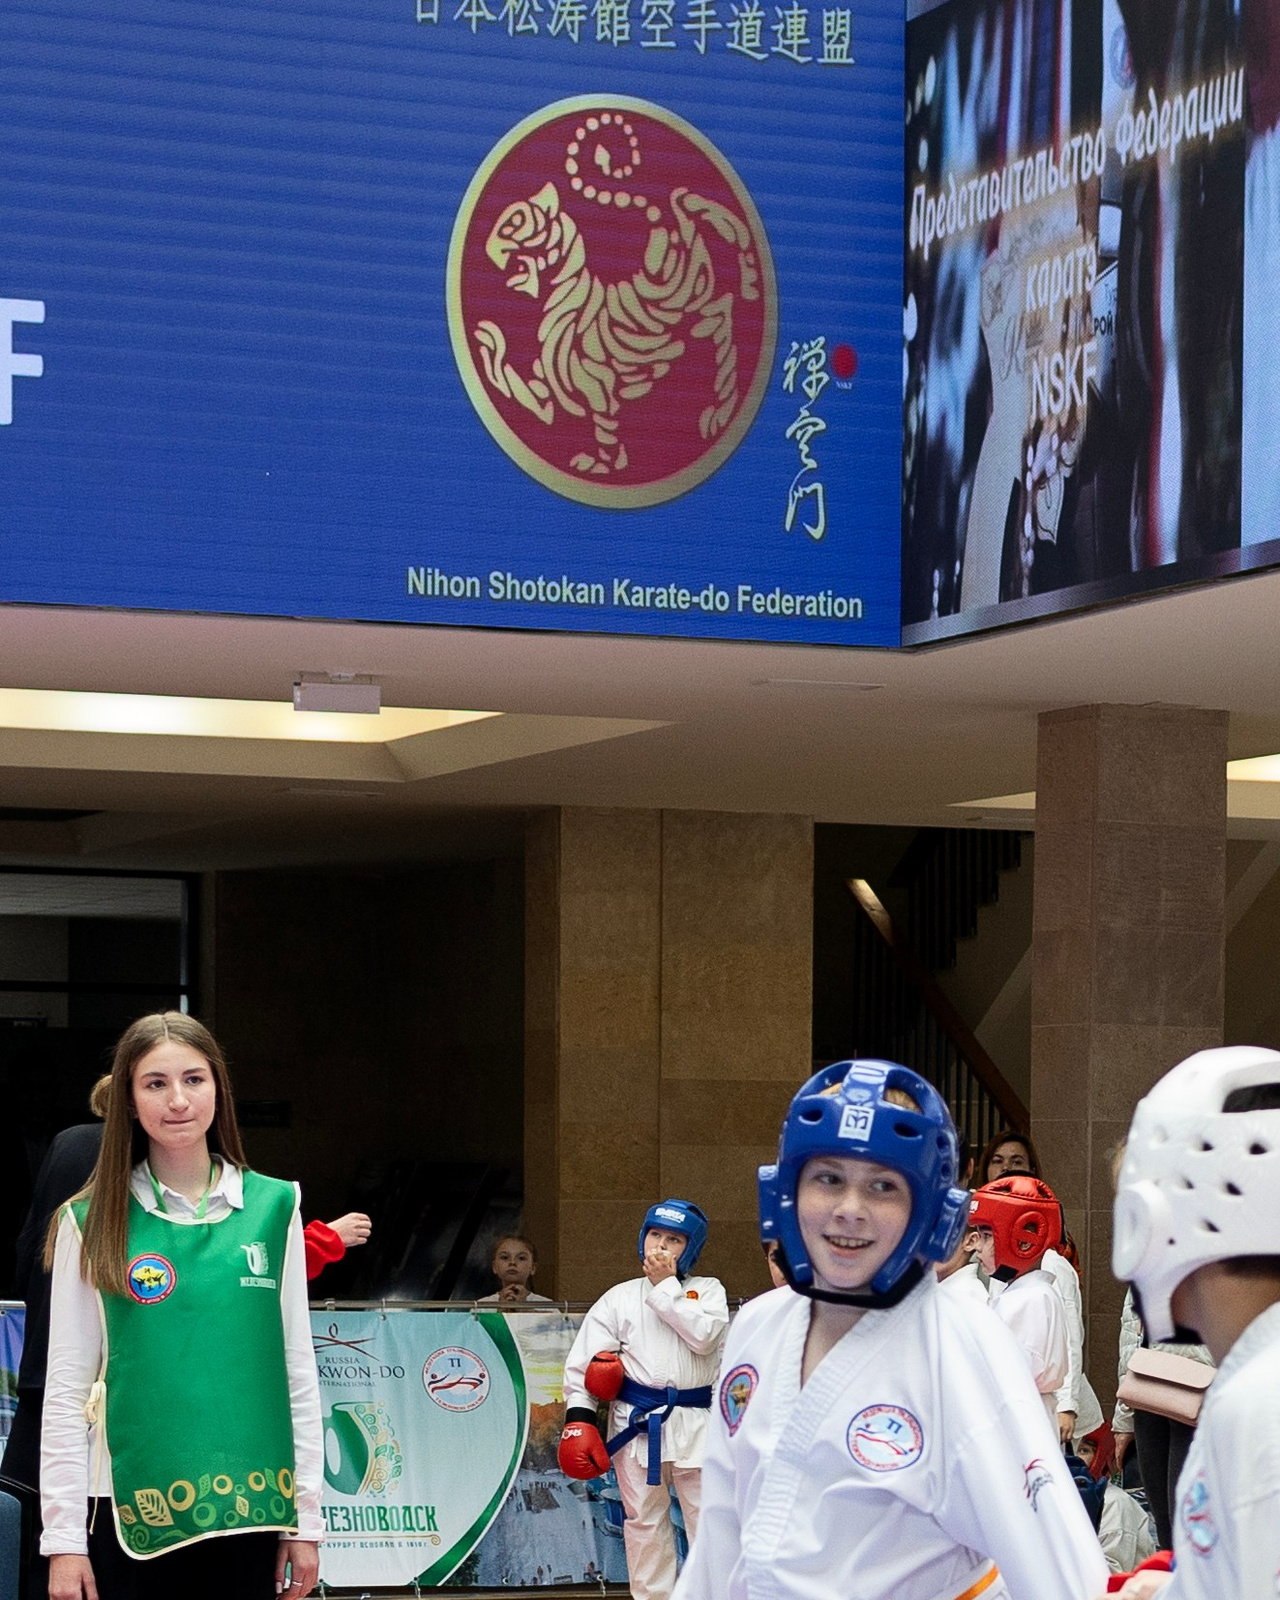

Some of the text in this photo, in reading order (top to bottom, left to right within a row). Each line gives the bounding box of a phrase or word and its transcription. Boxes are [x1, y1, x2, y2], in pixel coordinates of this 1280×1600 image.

[910, 67, 1244, 261] Представительство Федерации
[1026, 243, 1096, 322] каратэ
[1030, 341, 1097, 429] NSKF
[408, 567, 862, 618] Nihon Shotokan Karate-do Federation
